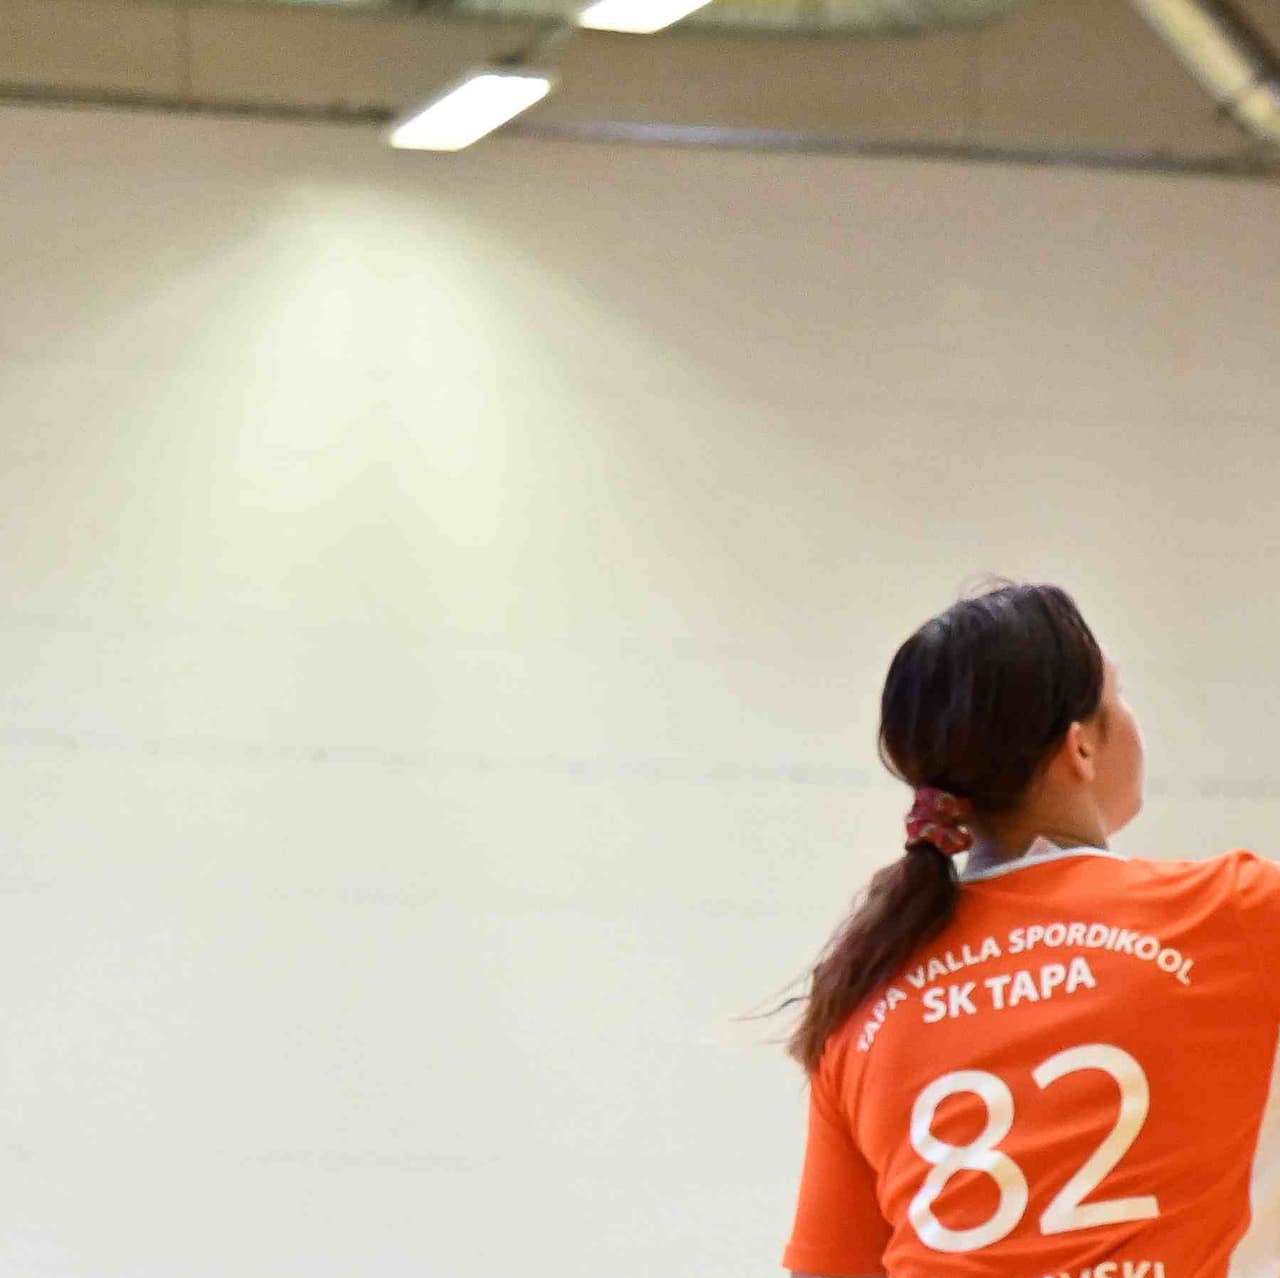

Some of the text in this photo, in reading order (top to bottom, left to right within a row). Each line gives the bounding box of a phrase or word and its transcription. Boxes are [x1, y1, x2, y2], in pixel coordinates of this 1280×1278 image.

[905, 936, 1002, 989] VALLA
[1008, 922, 1195, 986] SPORDIKOOL
[921, 956, 1096, 1023] SK TAPA
[907, 1042, 1160, 1253] 82
